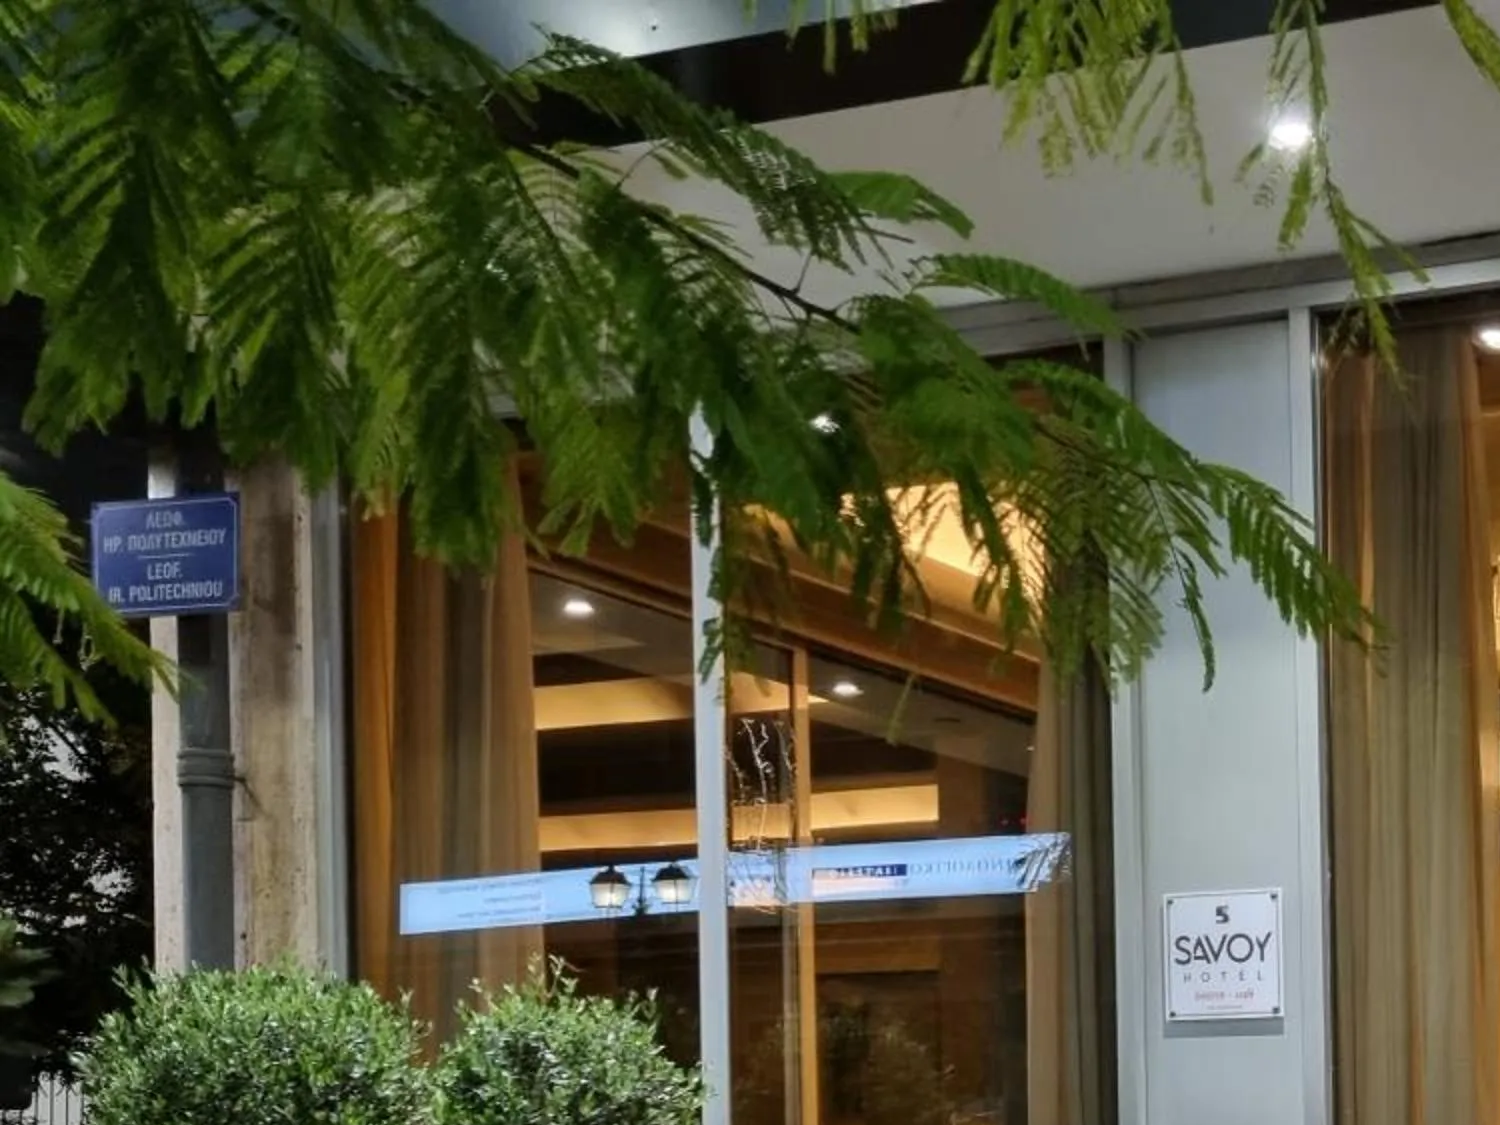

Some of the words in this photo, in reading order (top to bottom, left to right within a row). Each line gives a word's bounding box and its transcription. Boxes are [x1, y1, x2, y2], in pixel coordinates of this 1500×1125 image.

[128, 528, 227, 551] ΠΟΛΥΤΕΧΝΕΙΟΥ
[146, 561, 184, 580] LEOF.
[128, 580, 223, 602] POLITECHNIOU
[1174, 931, 1272, 965] SAVOY
[1183, 969, 1263, 983] HOTEL
